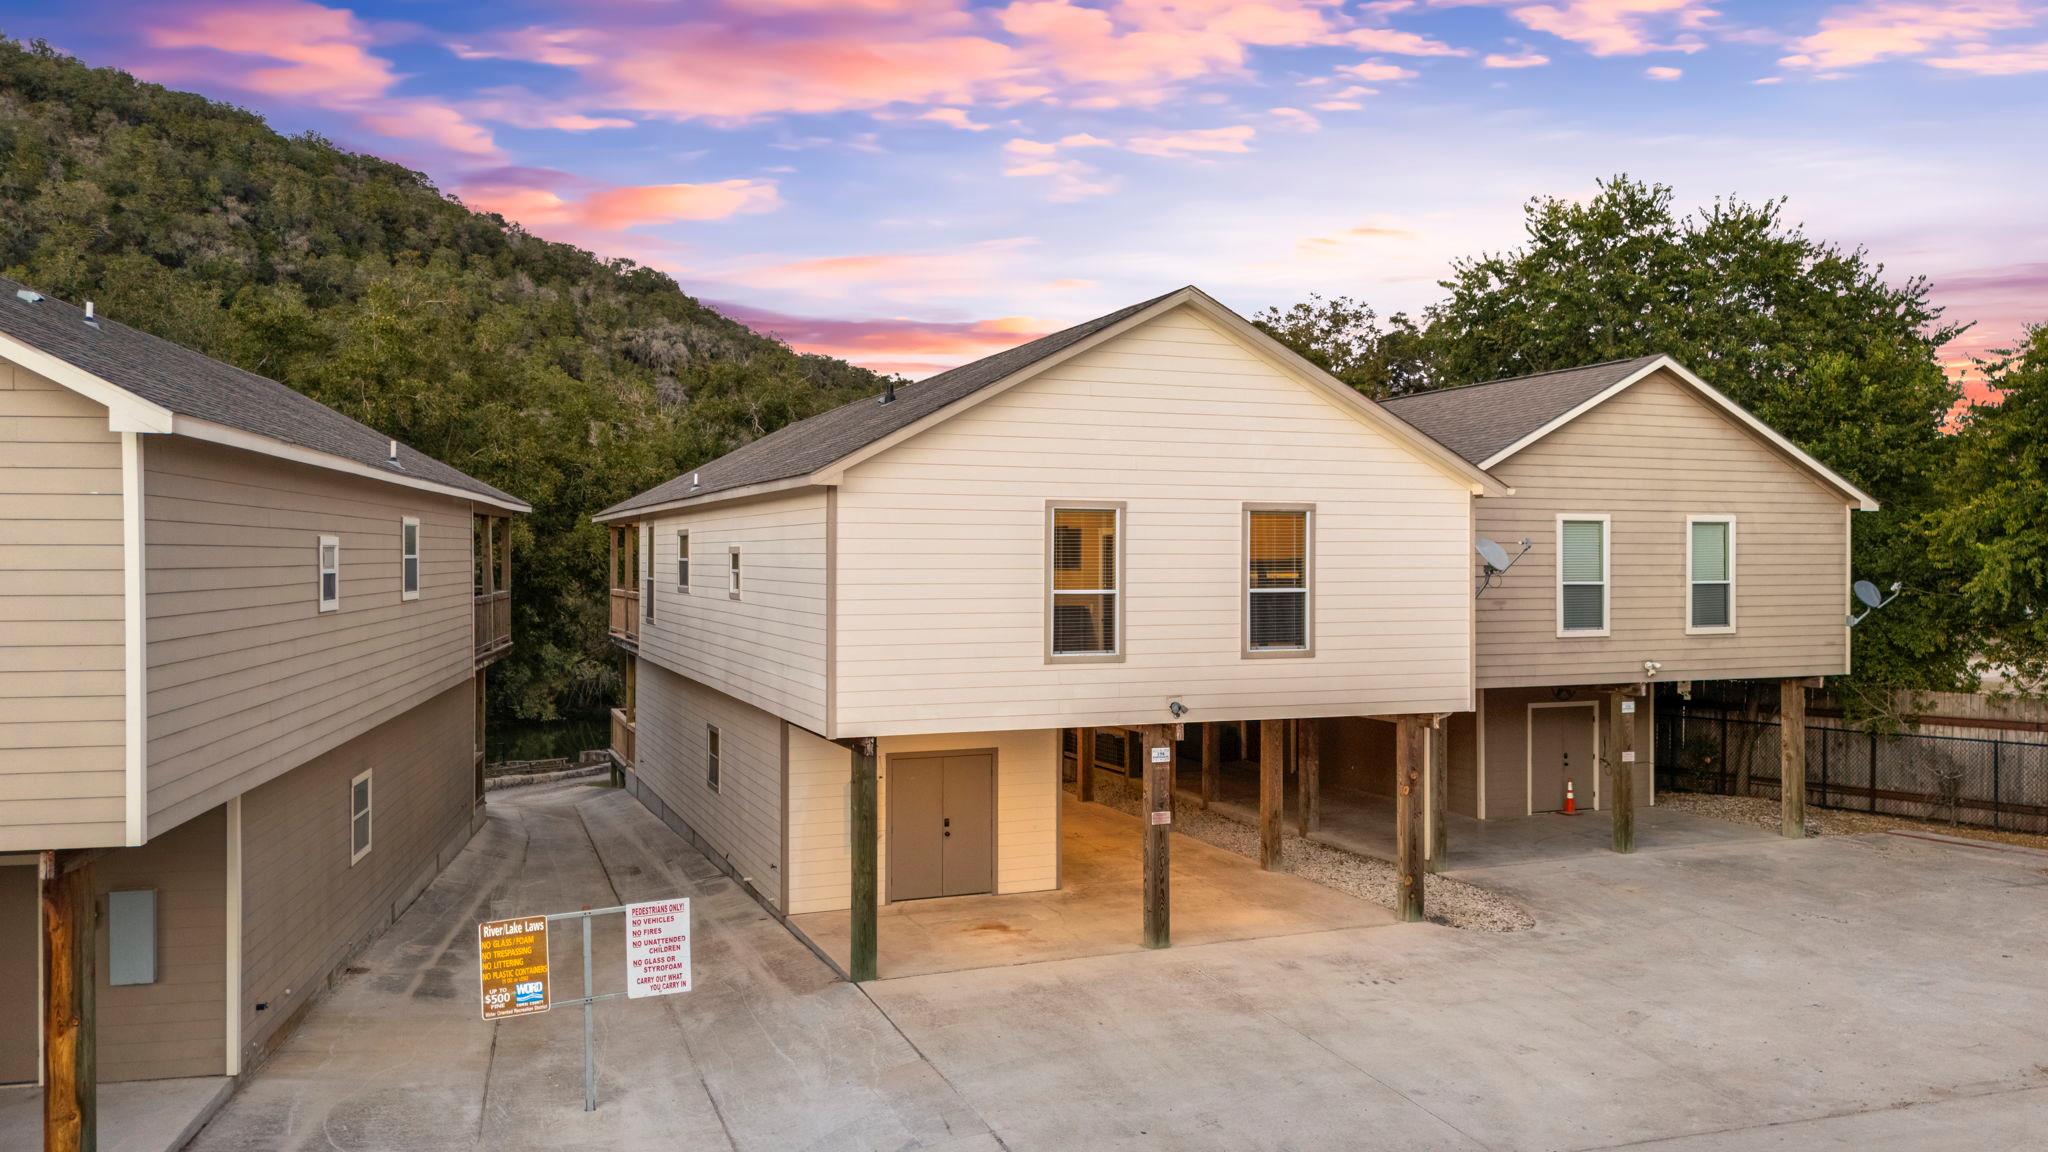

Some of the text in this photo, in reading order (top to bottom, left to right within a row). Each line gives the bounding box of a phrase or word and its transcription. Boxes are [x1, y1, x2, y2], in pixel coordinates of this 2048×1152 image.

[631, 905, 668, 916] PEDESTRIANS
[643, 915, 675, 925] VEHICLES
[483, 921, 545, 938] River/Lake Laws
[643, 927, 662, 936] FIRES
[481, 940, 491, 949] NO
[632, 935, 686, 948] NO UNATTENDED
[481, 946, 533, 960] NO TRESPASSING
[649, 945, 681, 954] CHILDREN
[482, 958, 524, 970] NO LITTERING
[644, 956, 665, 965] GLASS
[482, 972, 492, 981] NO
[492, 969, 514, 979] PLASTIC
[514, 965, 548, 977] CONTAINERS
[643, 963, 683, 973] STYROFOAM
[636, 976, 655, 984] CARRY
[655, 975, 667, 983] OUT
[515, 981, 543, 995] WORD
[662, 981, 680, 990] CARRY
[484, 992, 511, 1004] $500
